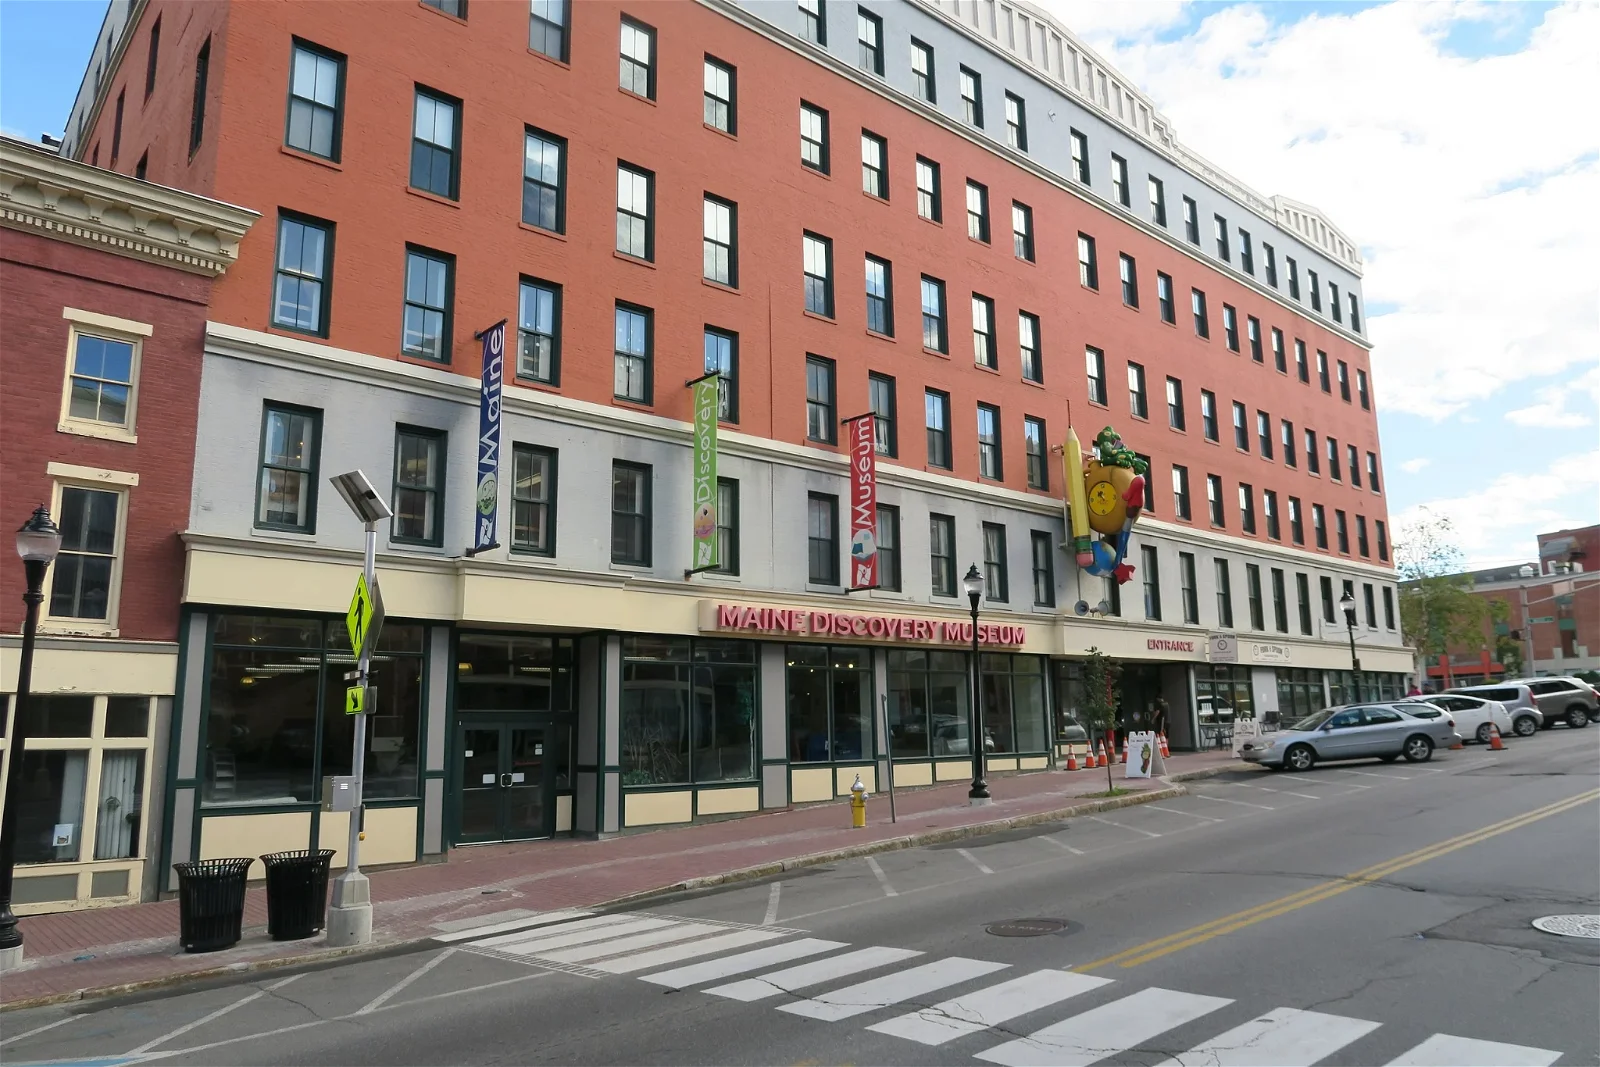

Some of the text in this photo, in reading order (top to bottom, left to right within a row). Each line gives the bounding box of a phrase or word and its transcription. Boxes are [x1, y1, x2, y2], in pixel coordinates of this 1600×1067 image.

[479, 329, 502, 467] Maine
[695, 380, 714, 503] Discovery
[854, 417, 872, 526] Museum
[717, 604, 1026, 645] MAINE DISCOVERY MUSEUM
[1147, 639, 1195, 652] ENTRANCE
